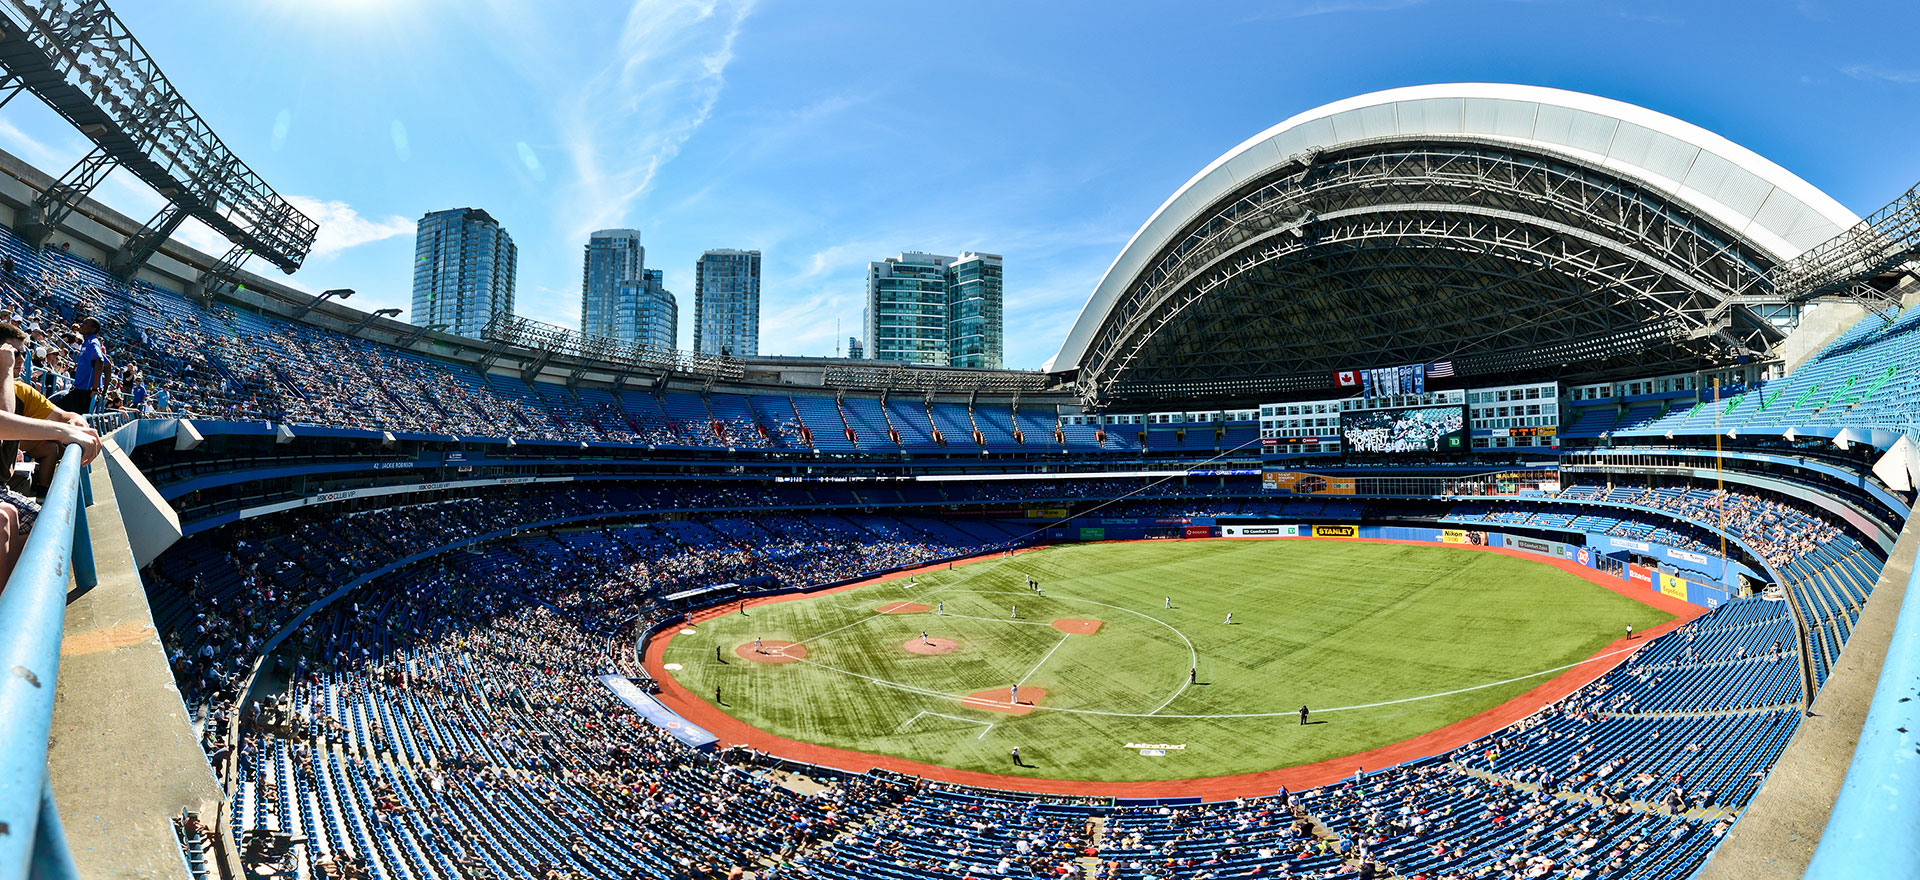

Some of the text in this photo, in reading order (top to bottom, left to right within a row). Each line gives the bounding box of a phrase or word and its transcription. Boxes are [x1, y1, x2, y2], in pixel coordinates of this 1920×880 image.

[1414, 378, 1422, 386] 12
[1344, 428, 1391, 438] GREATEST
[1348, 436, 1388, 445] MOMENT
[1355, 444, 1365, 452] IN
[1366, 443, 1385, 451] THE
